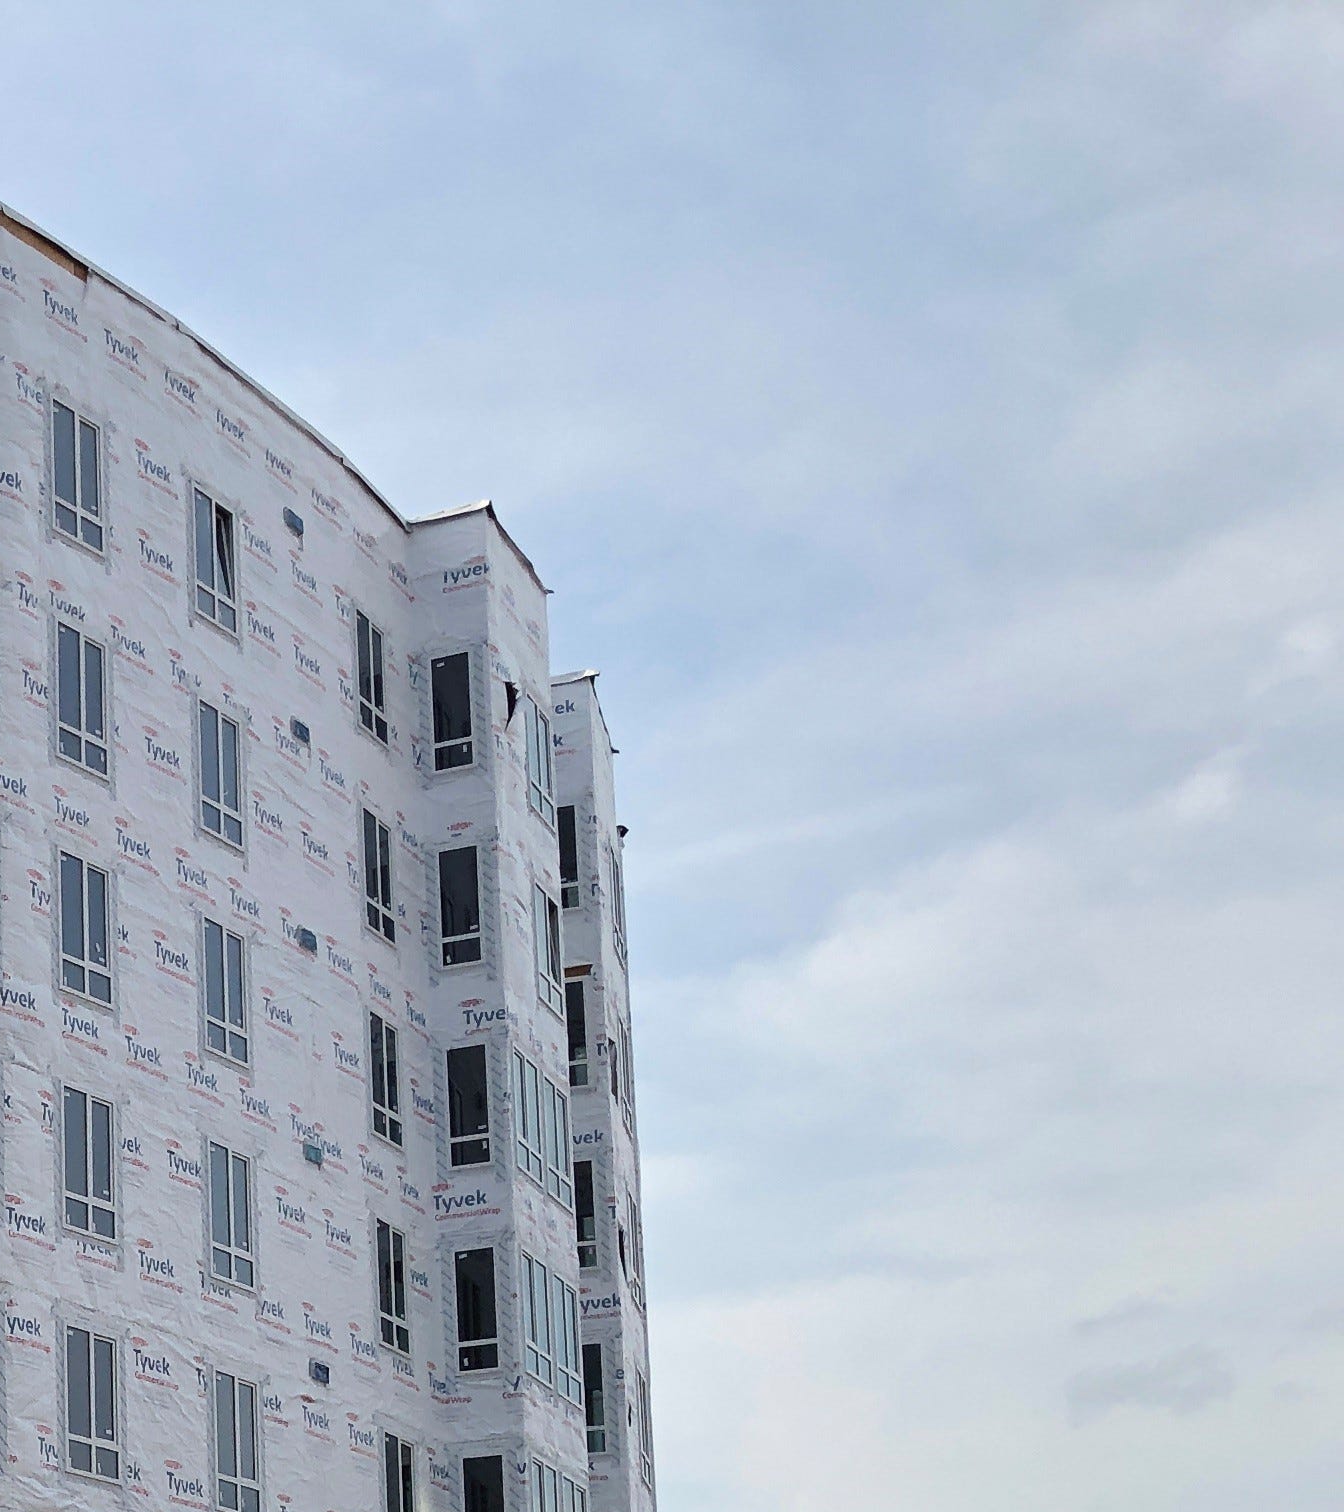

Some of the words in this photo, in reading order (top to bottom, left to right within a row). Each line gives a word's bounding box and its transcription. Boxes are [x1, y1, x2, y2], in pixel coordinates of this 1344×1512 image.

[43, 289, 78, 325] Tyvek
[136, 445, 170, 488] Tyvek
[139, 538, 172, 572] Tyvek
[111, 625, 145, 661] Tyvek
[247, 610, 274, 644] Tyvek
[294, 644, 320, 678] Tyvek
[145, 736, 179, 769] Tyvek
[54, 796, 89, 827] Tyvek
[116, 828, 150, 863] Tyvek
[176, 857, 208, 889] Tyvek
[154, 940, 188, 971] Tyvek
[62, 1006, 98, 1039] Tyvek
[125, 1035, 161, 1067] Tyvek
[167, 1150, 202, 1180] Tyvek
[276, 1197, 305, 1225] Tyvek
[433, 1190, 487, 1215] Tyvek
[6, 1207, 45, 1237] Tyvek
[138, 1250, 174, 1278] Tyvek
[133, 1349, 170, 1379] Tyvek
[302, 1405, 329, 1431] Tyvek
[167, 1471, 203, 1500] Tyvek
